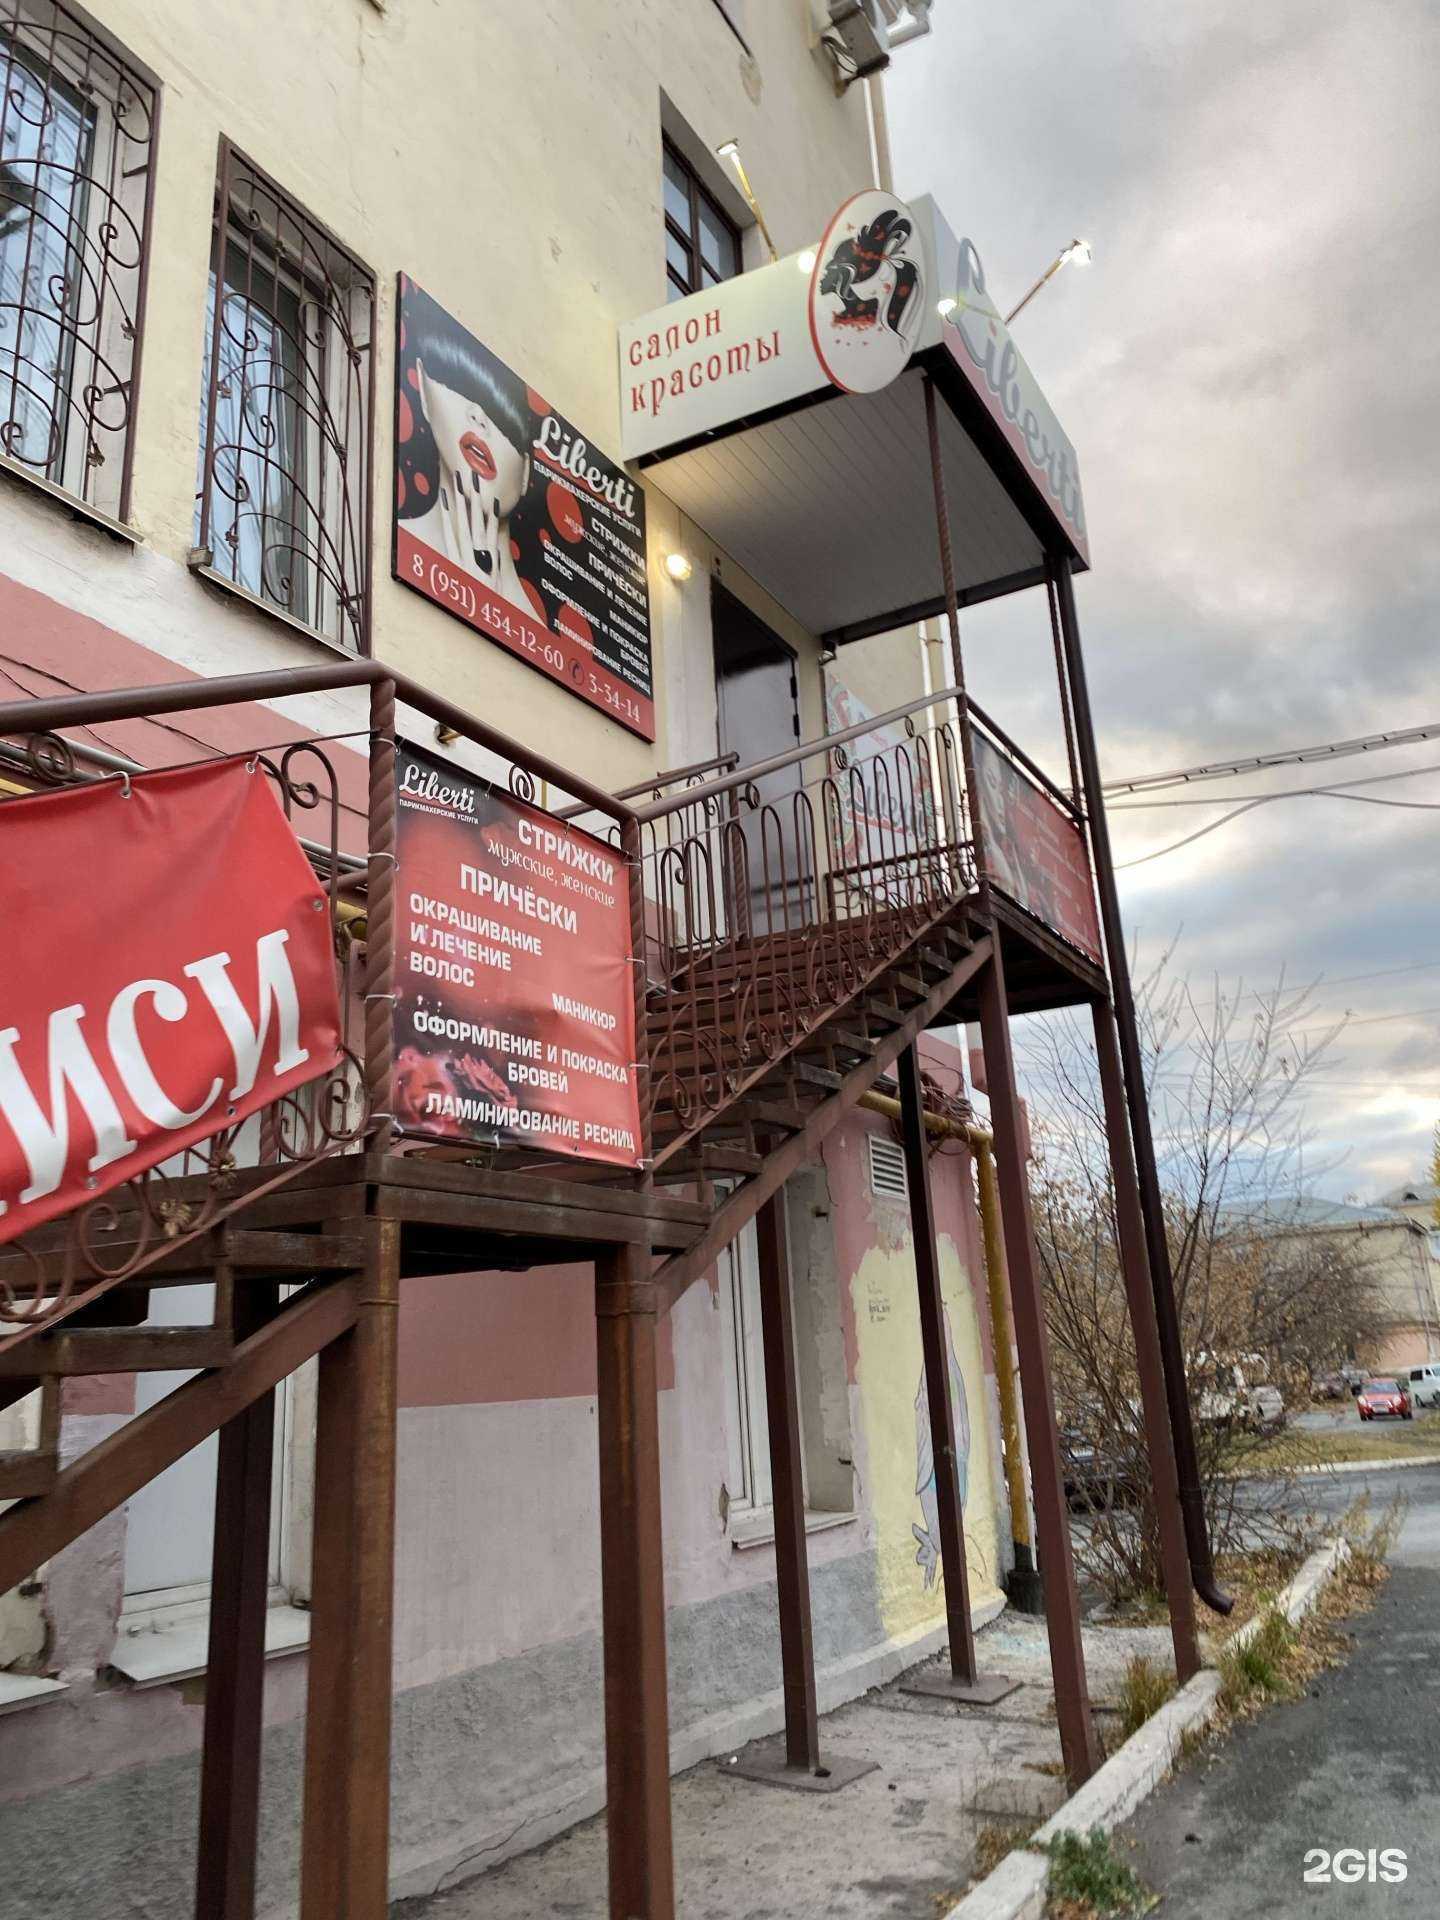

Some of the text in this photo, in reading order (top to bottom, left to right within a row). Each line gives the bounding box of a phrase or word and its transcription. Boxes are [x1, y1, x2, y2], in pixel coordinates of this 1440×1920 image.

[629, 309, 722, 366] салон
[631, 329, 782, 418] красоты
[533, 416, 636, 518] Liberti
[533, 460, 642, 538] ПАРИКМАХЕРСКИЕ УСЛУГИ
[543, 551, 574, 581] ВОЛОС
[591, 517, 646, 571] СТРИЖКИ
[543, 539, 648, 626] ОКРАШИВАНИЕ И ЛЕЧЕНИЕ
[588, 552, 647, 609] ПРИЧЁСКИ
[411, 553, 641, 724] 8 (951) 454-12-60 3-34-14
[541, 578, 649, 664] ОФОРМЛЕНИЕ И ПОКРАСКА
[553, 618, 622, 672] ЛАМИНИРОВАНИЕ
[609, 610, 649, 644] МАНИКЮР
[619, 648, 650, 677] БРОВЕЙ
[398, 764, 475, 813] Liberti
[399, 799, 479, 825] ПАРИКМАХЕРСКИЕ УСЛУГИ
[487, 838, 616, 909] мужские, женские
[518, 818, 614, 886] СТРИЖКИ
[409, 893, 543, 956] ОКРАШИВАНИЕ
[460, 863, 577, 934] ПРИЧЁСКИ
[409, 951, 475, 987] ВОЛОС
[410, 922, 512, 972] И ЛЕЧЕНИЕ
[551, 992, 616, 1031] МАНИКЮР
[0, 928, 310, 1216] ИСИ
[413, 1010, 628, 1084] ОФОРМЛЕНИЕ И ПОКРАСКА
[507, 1062, 569, 1094] БРОВЕЙ
[425, 1093, 635, 1152] ЛАМИНИРОВАНИЕ РЕСНИЦ
